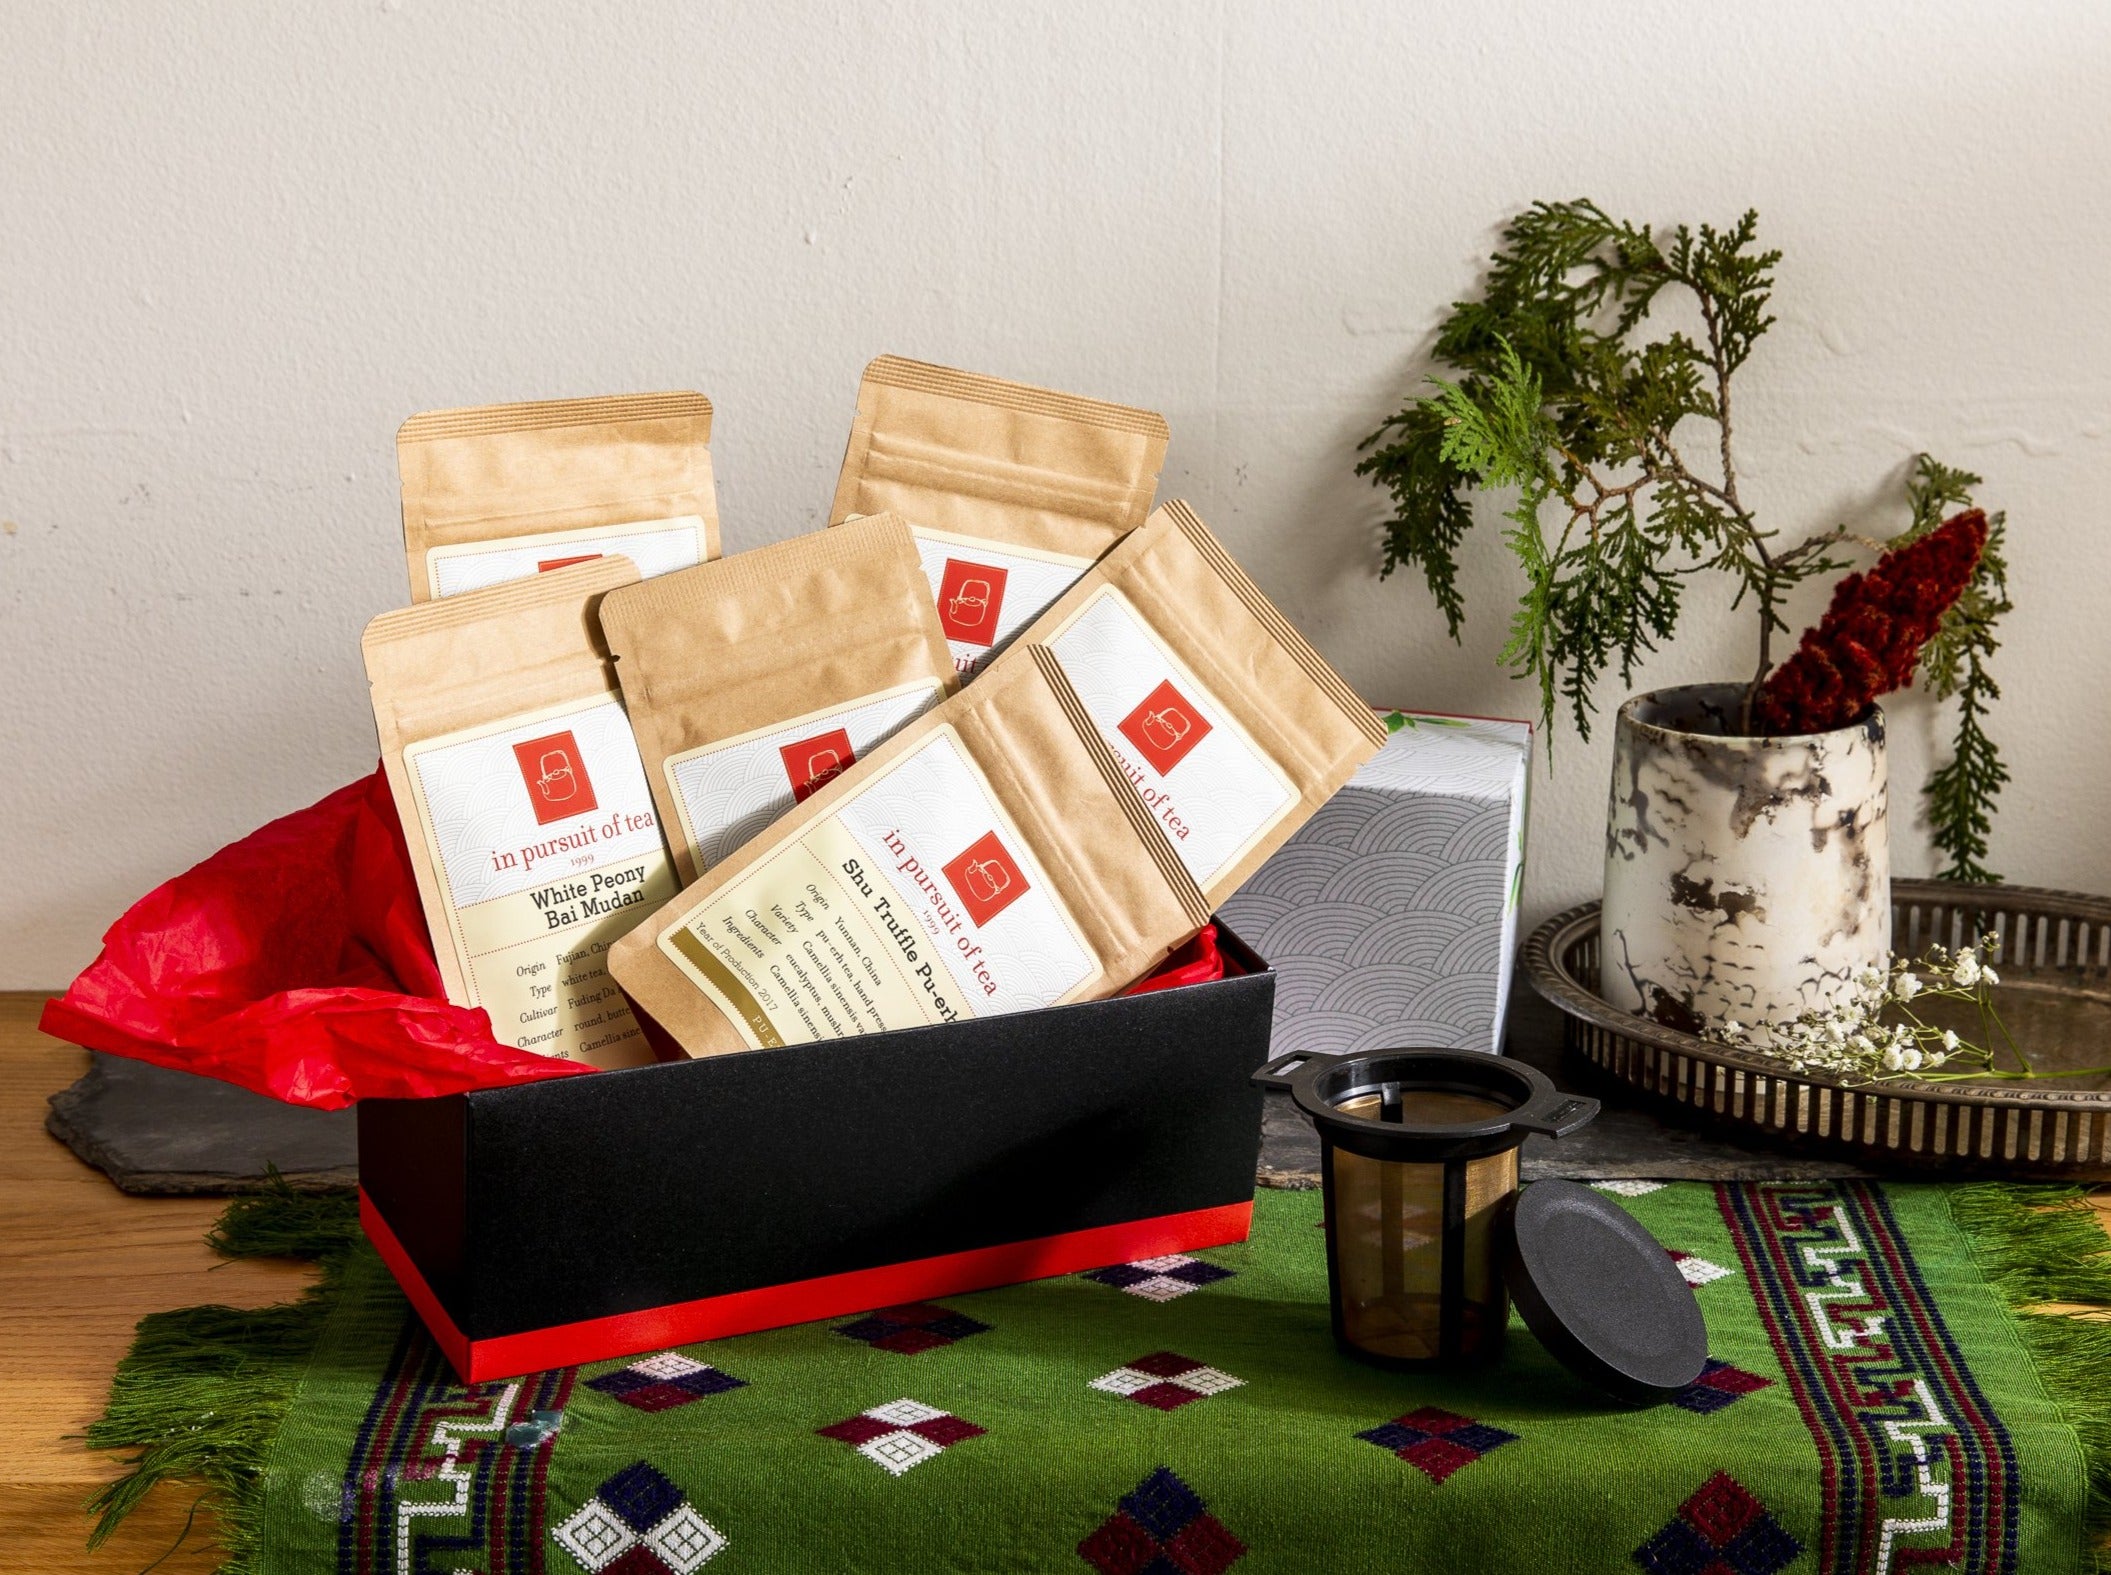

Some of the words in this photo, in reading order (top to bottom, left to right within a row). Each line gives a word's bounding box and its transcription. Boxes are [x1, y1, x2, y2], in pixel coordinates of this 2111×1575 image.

[1142, 788, 1170, 811] of
[1162, 806, 1190, 841] tea
[491, 850, 518, 871] in
[520, 825, 598, 871] pursuit
[602, 813, 623, 838] of
[624, 812, 654, 832] tea
[570, 854, 595, 867] 1999
[530, 884, 587, 910] White
[590, 866, 645, 892] Peony
[544, 906, 580, 929] Bai
[580, 889, 645, 918] Mudan
[806, 884, 830, 910] Origin
[834, 916, 862, 958] Yunnan,
[861, 956, 882, 986] China
[882, 829, 907, 857] in
[896, 855, 962, 935] pursuit
[957, 936, 983, 961] of
[972, 959, 998, 997] tea
[922, 909, 940, 936] 1999
[516, 962, 546, 977] Origin
[556, 950, 590, 965] Fujian,
[590, 940, 617, 954] Chin
[722, 916, 765, 959] Ingredients
[769, 964, 800, 1008] Camellia
[744, 909, 783, 946] Character
[785, 953, 821, 1006] eucalyptus,
[770, 904, 799, 934] Variety
[802, 940, 833, 984] Camellia
[830, 982, 862, 1023] sinensis
[795, 900, 814, 922] Type
[816, 930, 845, 964] pu-erh
[841, 962, 853, 982] tea,
[853, 980, 874, 1008] hand
[841, 858, 873, 898] Shu
[874, 896, 918, 963] Truffle
[915, 962, 958, 1024] Pu-erh
[529, 984, 552, 999] Type
[561, 972, 589, 987] white
[590, 968, 606, 978] tea,
[696, 921, 714, 941] Year
[712, 940, 726, 951] of
[720, 948, 759, 990] Production
[757, 988, 779, 1011] 2017
[520, 1005, 558, 1024] Cultivar
[567, 992, 602, 1009] Fuding
[602, 987, 616, 998] Da
[517, 1028, 563, 1048] Character
[574, 1014, 606, 1031] round,
[579, 1033, 621, 1052] Camellia
[752, 1014, 780, 1047] PU-E
